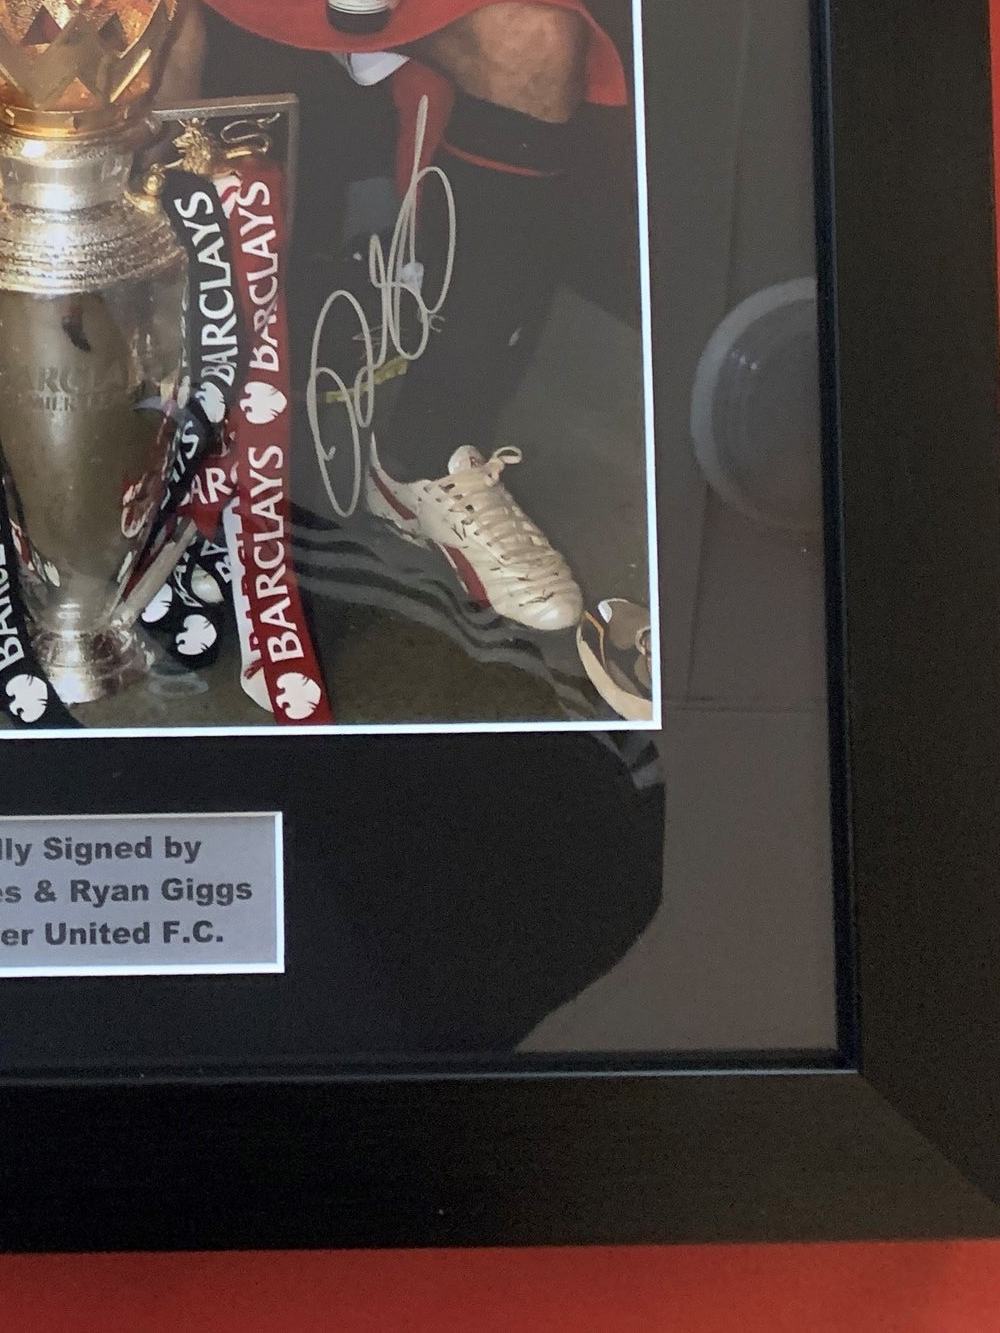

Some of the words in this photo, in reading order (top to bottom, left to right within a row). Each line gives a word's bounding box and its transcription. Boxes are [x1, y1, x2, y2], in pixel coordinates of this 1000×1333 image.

[173, 191, 240, 387] BARCLAYS
[248, 445, 304, 664] BARCLAYS
[43, 835, 153, 866] Signed
[164, 835, 204, 865] by
[33, 879, 58, 904] &
[70, 878, 150, 909] Ryan
[160, 877, 253, 907] Giggs
[44, 921, 151, 946] United
[162, 919, 224, 944] F.C.
